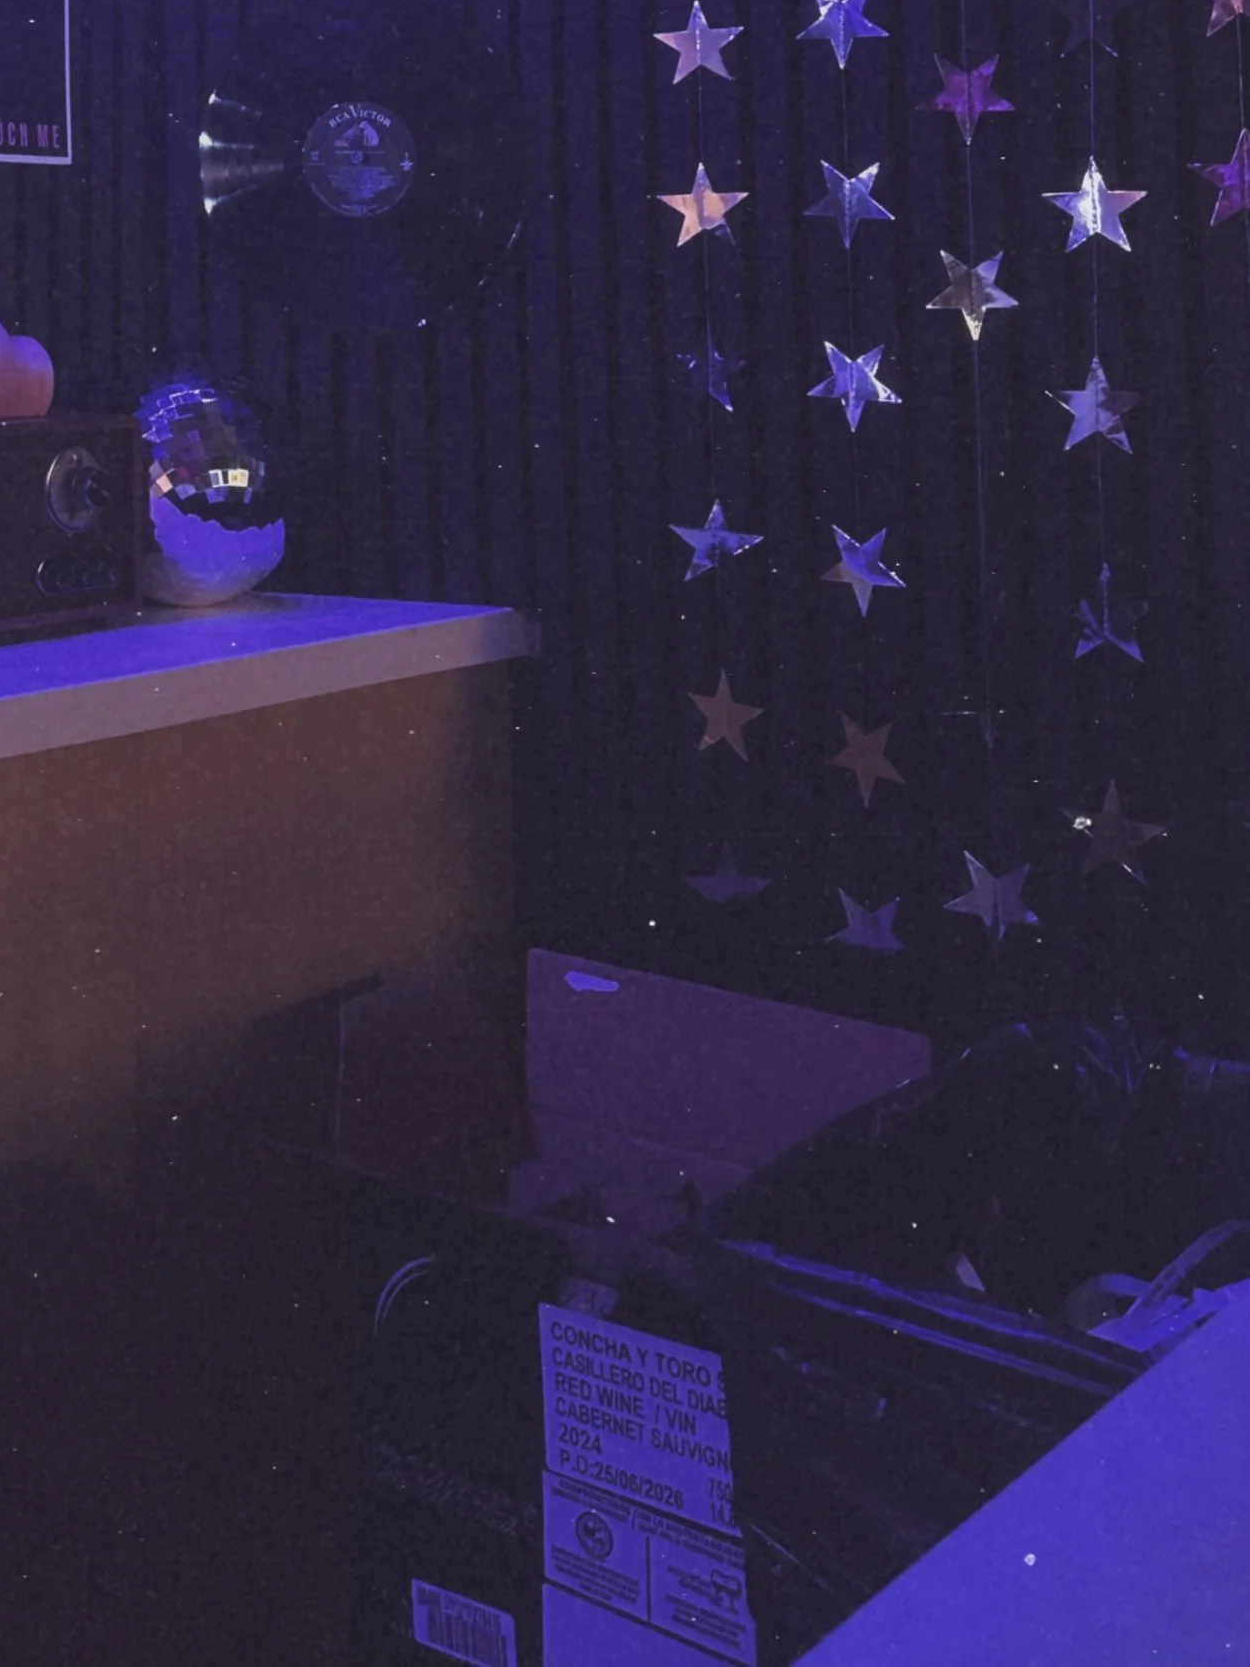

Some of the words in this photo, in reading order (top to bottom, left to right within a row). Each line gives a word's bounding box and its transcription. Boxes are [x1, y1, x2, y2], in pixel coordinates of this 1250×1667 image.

[37, 123, 60, 149] ME
[550, 1320, 632, 1364] CONCHA
[636, 1345, 649, 1369] Y
[653, 1351, 712, 1389] TORO
[551, 1345, 646, 1393] CASILLERO
[649, 1377, 684, 1406] DEL
[554, 1371, 592, 1401] RED
[595, 1382, 645, 1419] WINE
[664, 1405, 698, 1437] VIN
[554, 1395, 646, 1442] CABERNET
[557, 1420, 603, 1456] 2024
